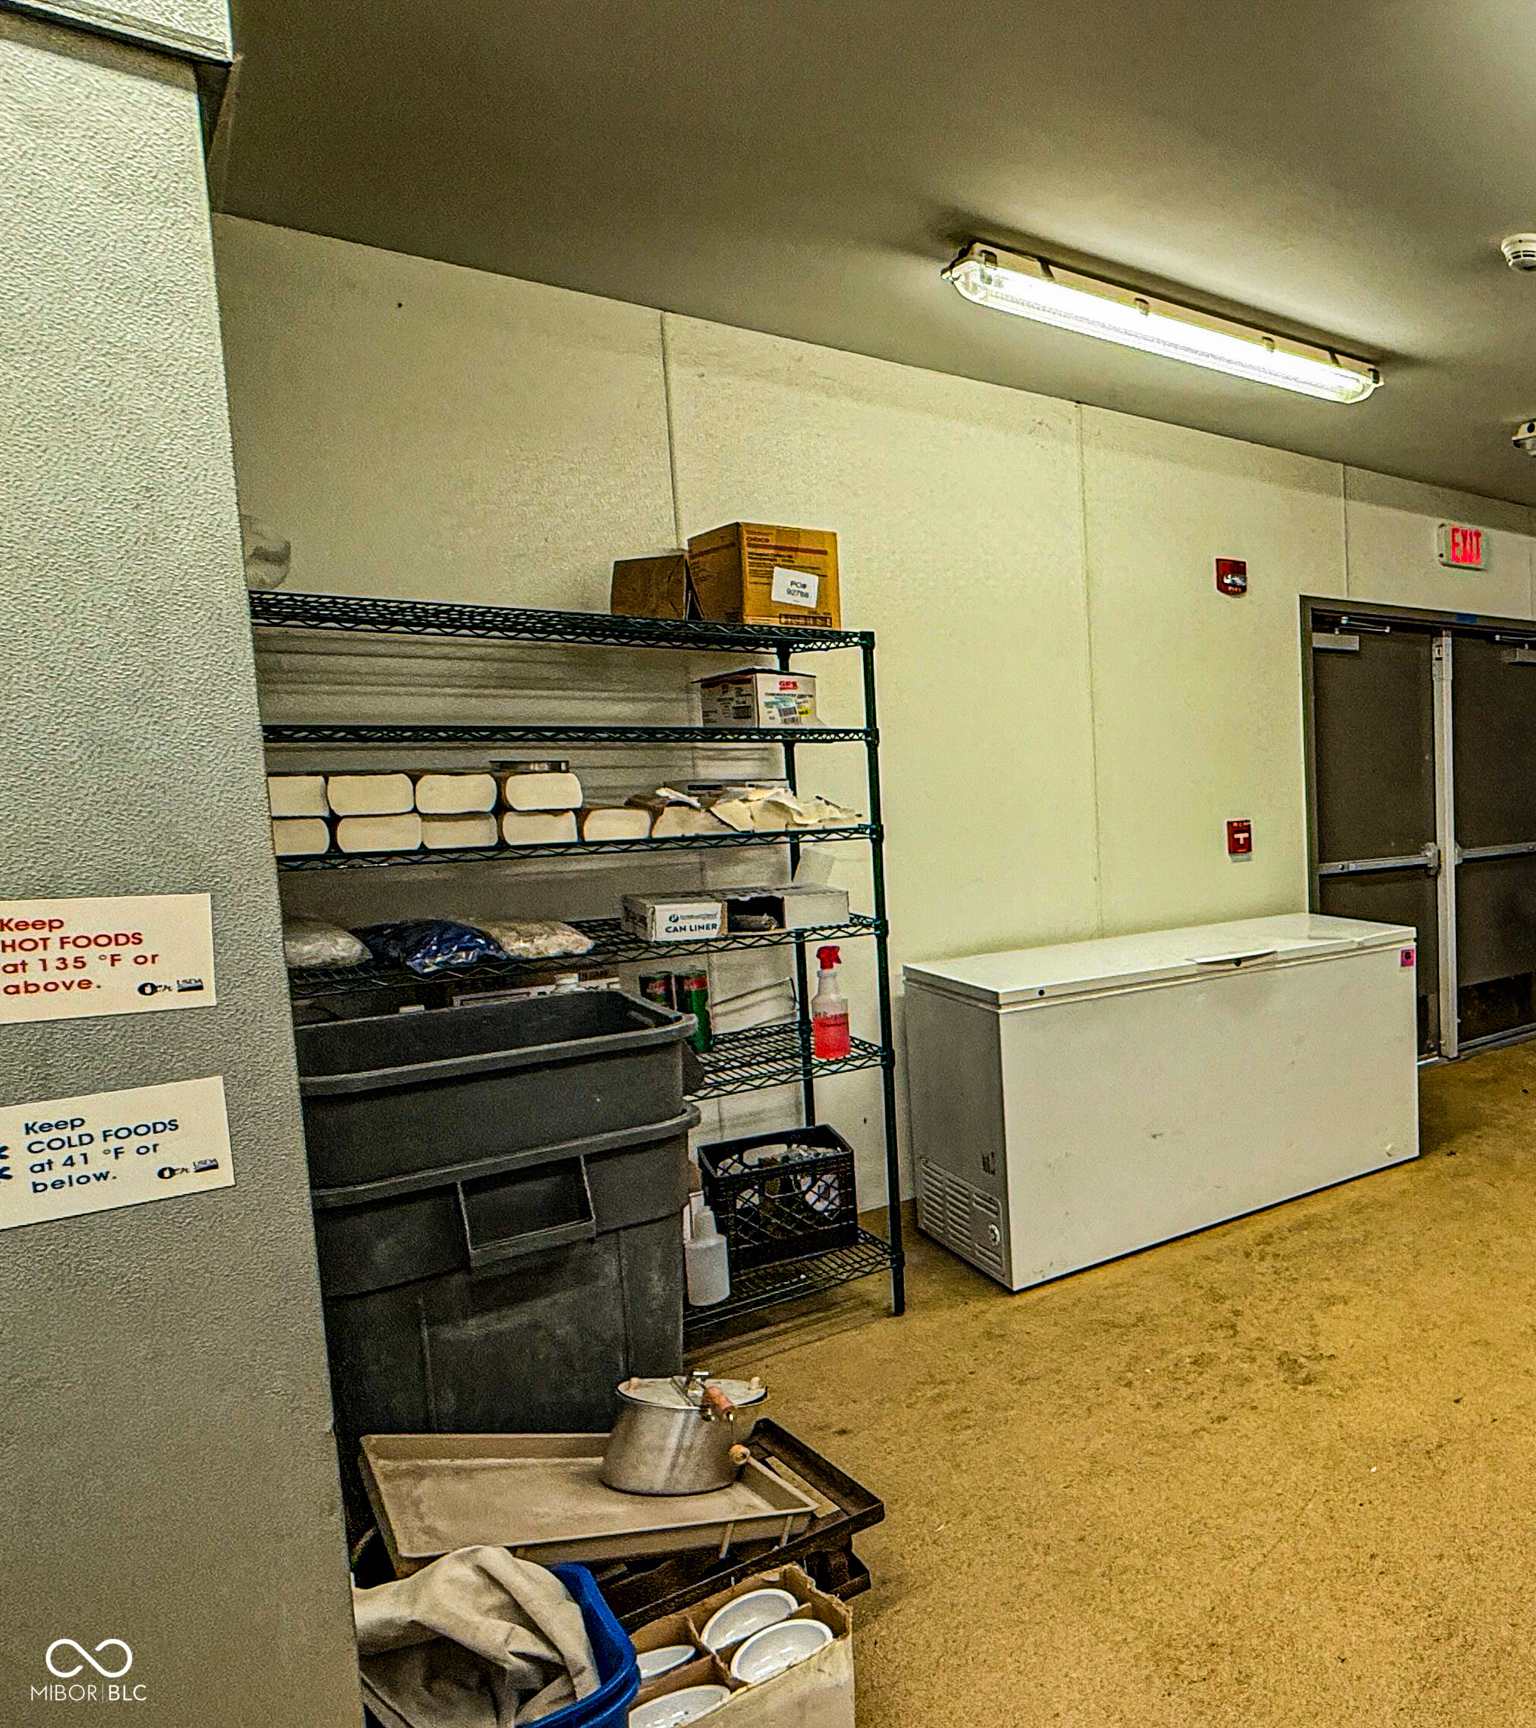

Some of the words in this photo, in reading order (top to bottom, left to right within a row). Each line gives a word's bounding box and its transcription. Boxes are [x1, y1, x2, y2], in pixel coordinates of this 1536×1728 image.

[1451, 526, 1482, 566] EXIT
[0, 918, 64, 932] Keep
[665, 925, 687, 934] CAN
[689, 923, 717, 932] LINER
[1, 937, 51, 953] HOT
[59, 932, 143, 950] FOODS
[2, 960, 28, 974] at
[38, 956, 87, 972] 135
[133, 954, 159, 965] or
[3, 978, 101, 995] above.
[24, 1117, 85, 1135] Keep
[27, 1133, 95, 1154] COLD
[102, 1119, 179, 1142] FOODS
[29, 1158, 53, 1174] at
[62, 1153, 88, 1168] 41
[136, 1143, 160, 1155] or
[32, 1170, 116, 1193] below.
